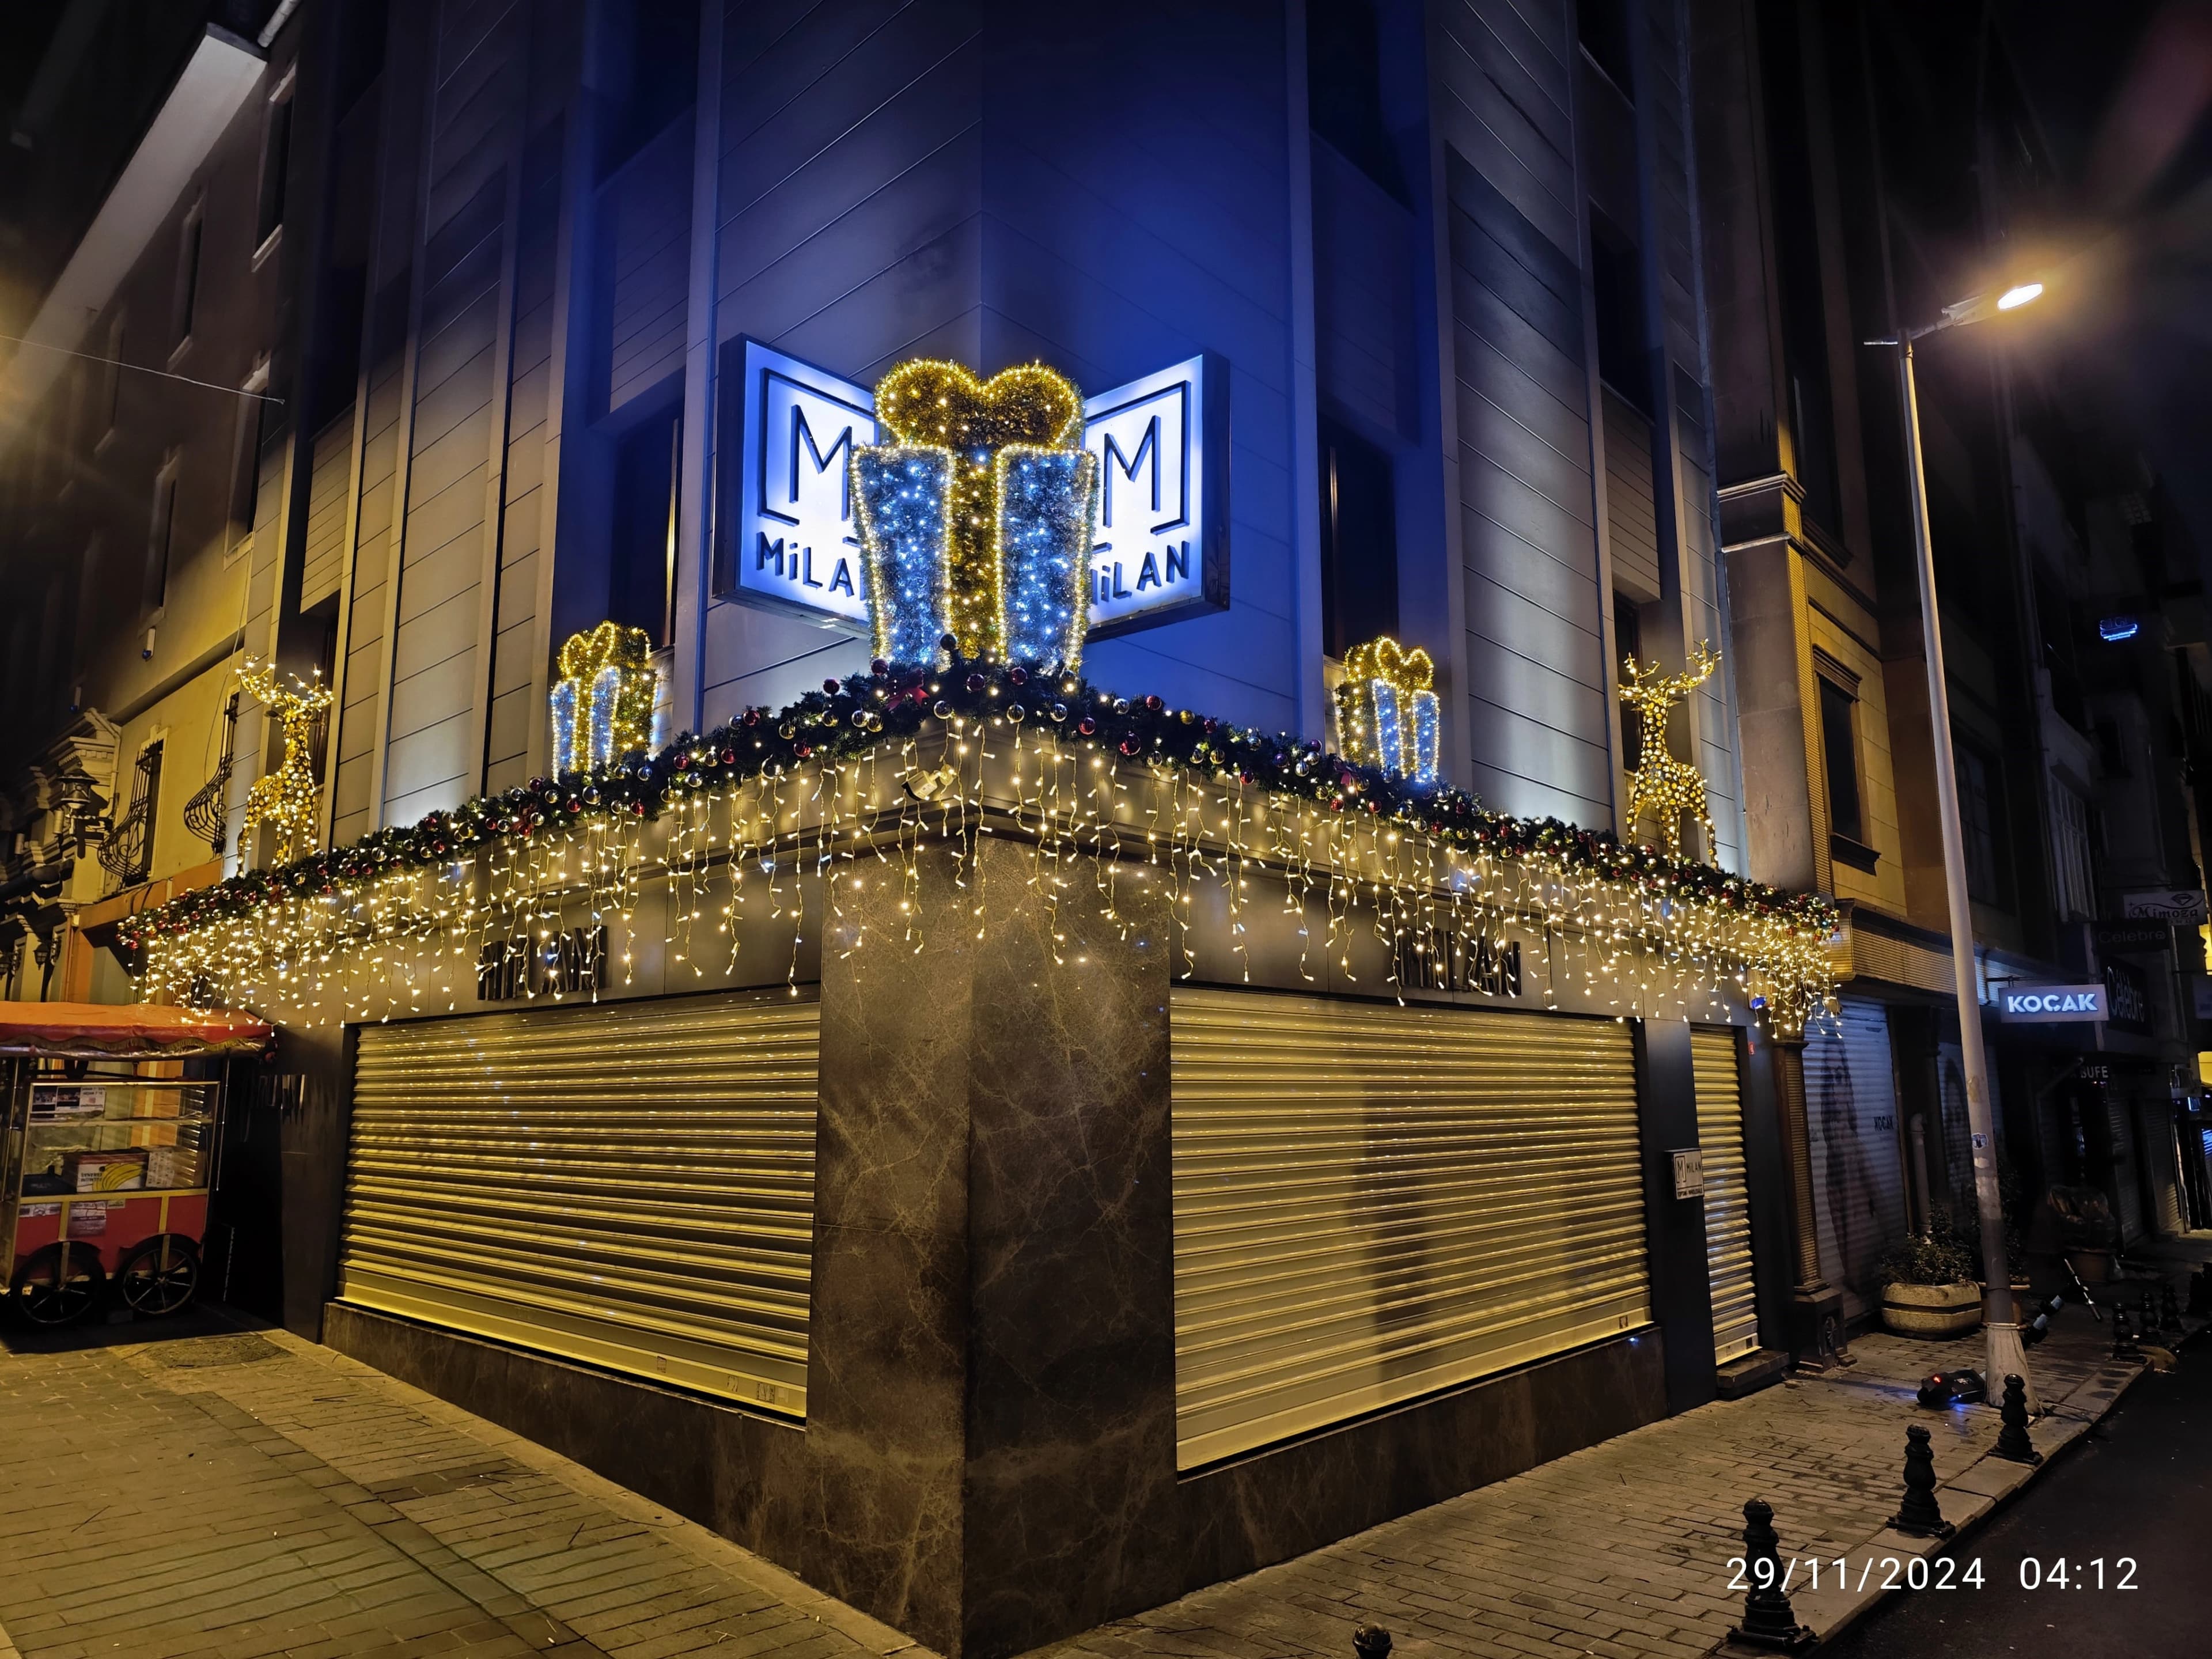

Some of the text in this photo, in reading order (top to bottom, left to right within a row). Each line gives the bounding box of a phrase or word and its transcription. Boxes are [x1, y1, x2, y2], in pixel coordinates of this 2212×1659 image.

[789, 404, 852, 521] M
[1103, 415, 1161, 528] M
[2130, 906, 2198, 919] Mimoza
